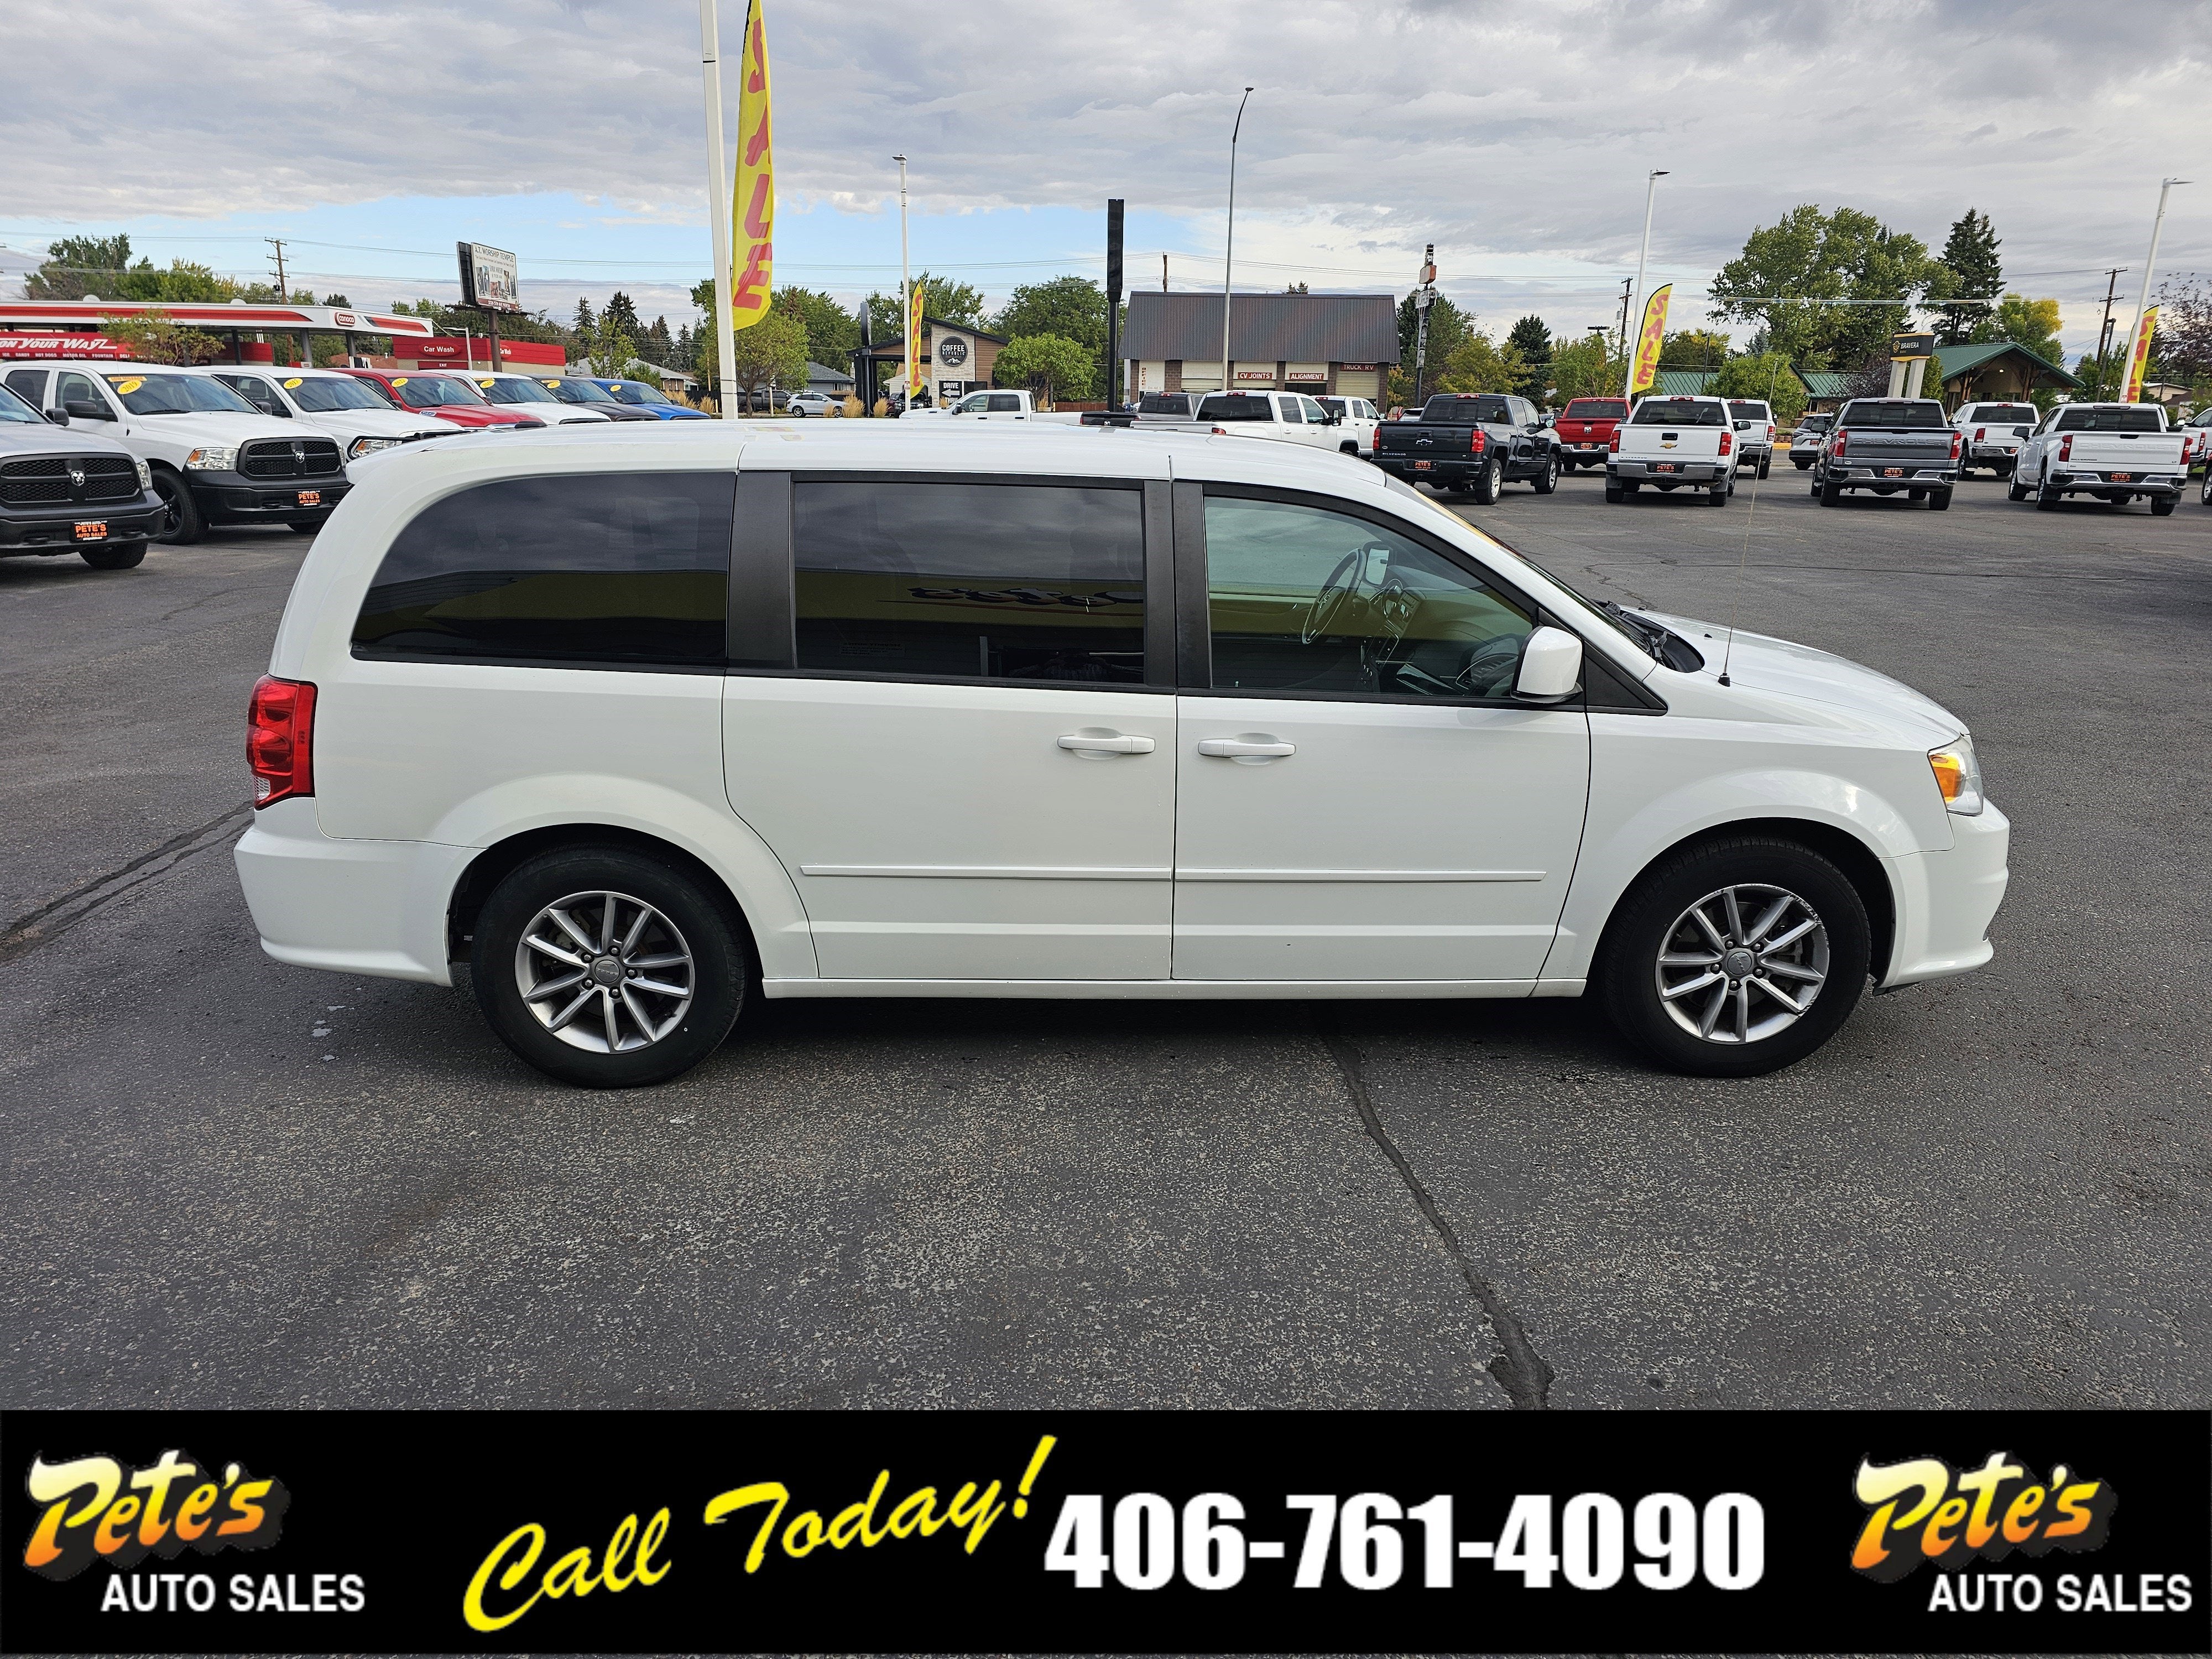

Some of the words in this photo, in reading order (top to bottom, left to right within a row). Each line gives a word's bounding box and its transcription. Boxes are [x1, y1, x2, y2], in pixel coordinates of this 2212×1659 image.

[482, 248, 499, 258] WORSHIP
[500, 252, 514, 263] TEMPLE
[1636, 294, 1668, 385] SALE
[75, 524, 107, 533] PETE'S
